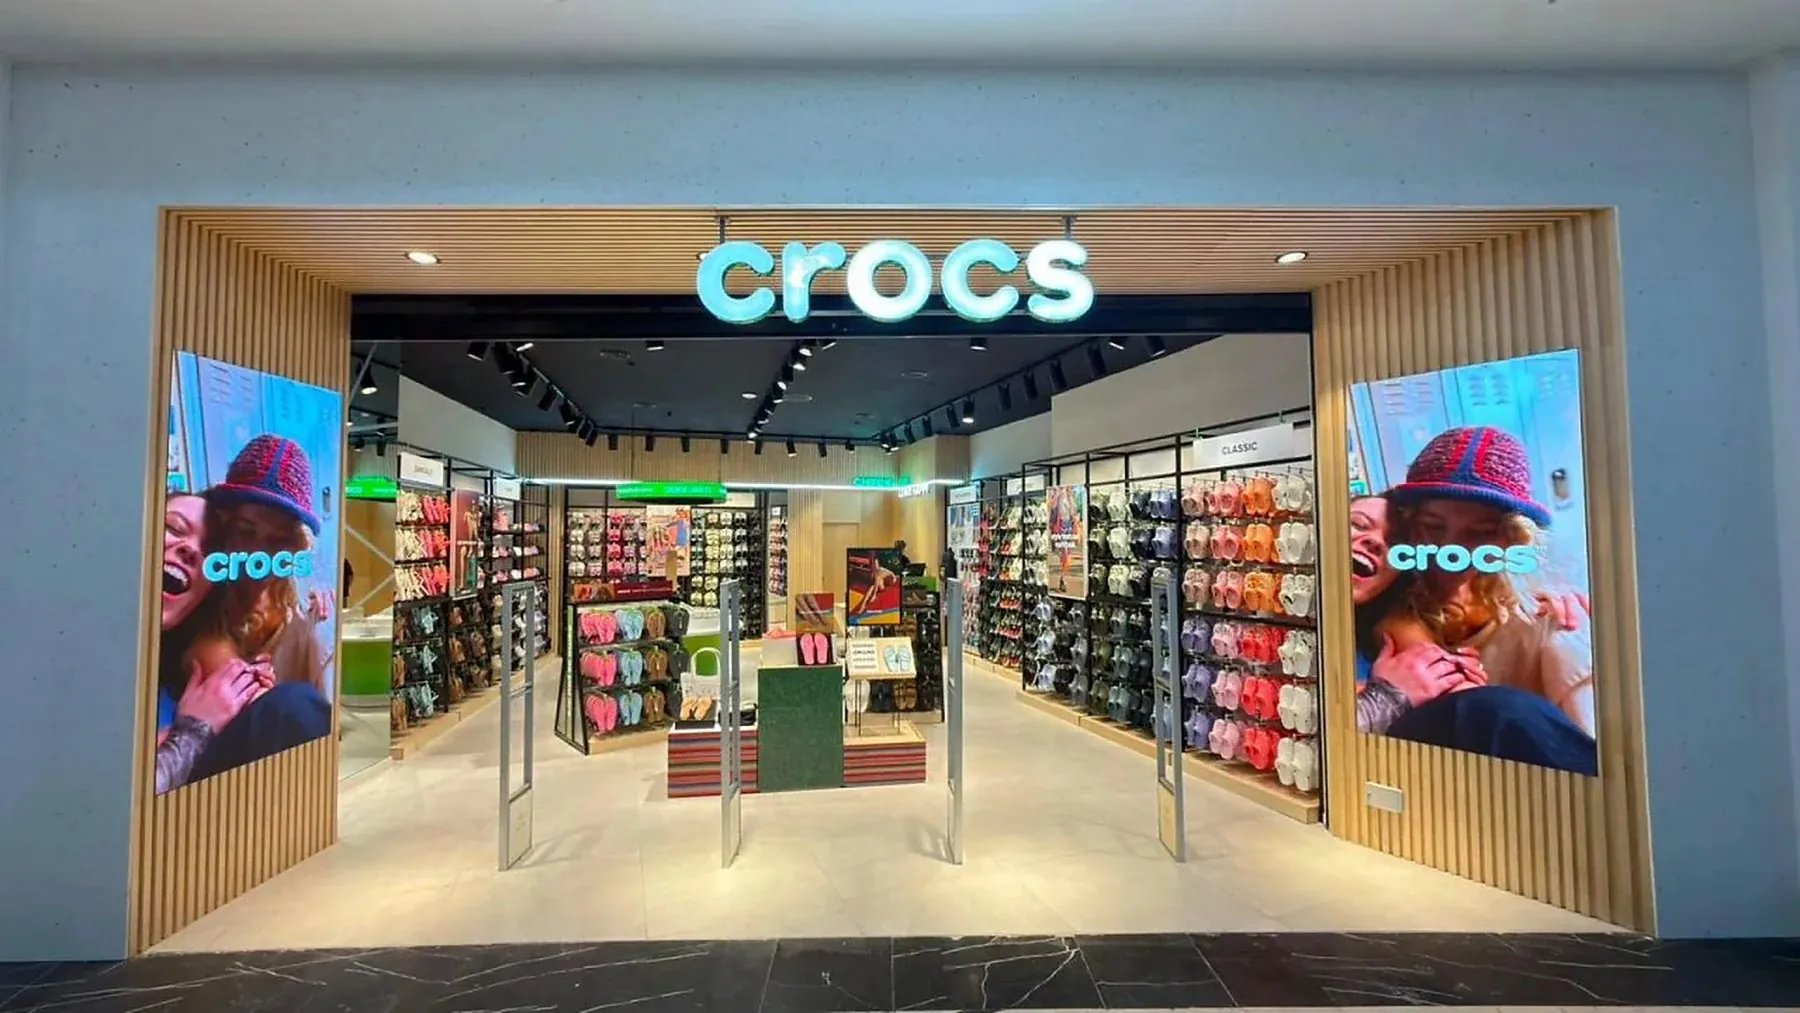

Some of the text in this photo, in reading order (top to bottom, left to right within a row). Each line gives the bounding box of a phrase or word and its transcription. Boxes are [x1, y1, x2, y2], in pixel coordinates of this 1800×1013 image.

[696, 240, 1094, 323] crocs
[1221, 442, 1258, 455] CLASSIC
[202, 551, 312, 581] crocs
[1387, 544, 1537, 573] crocs
